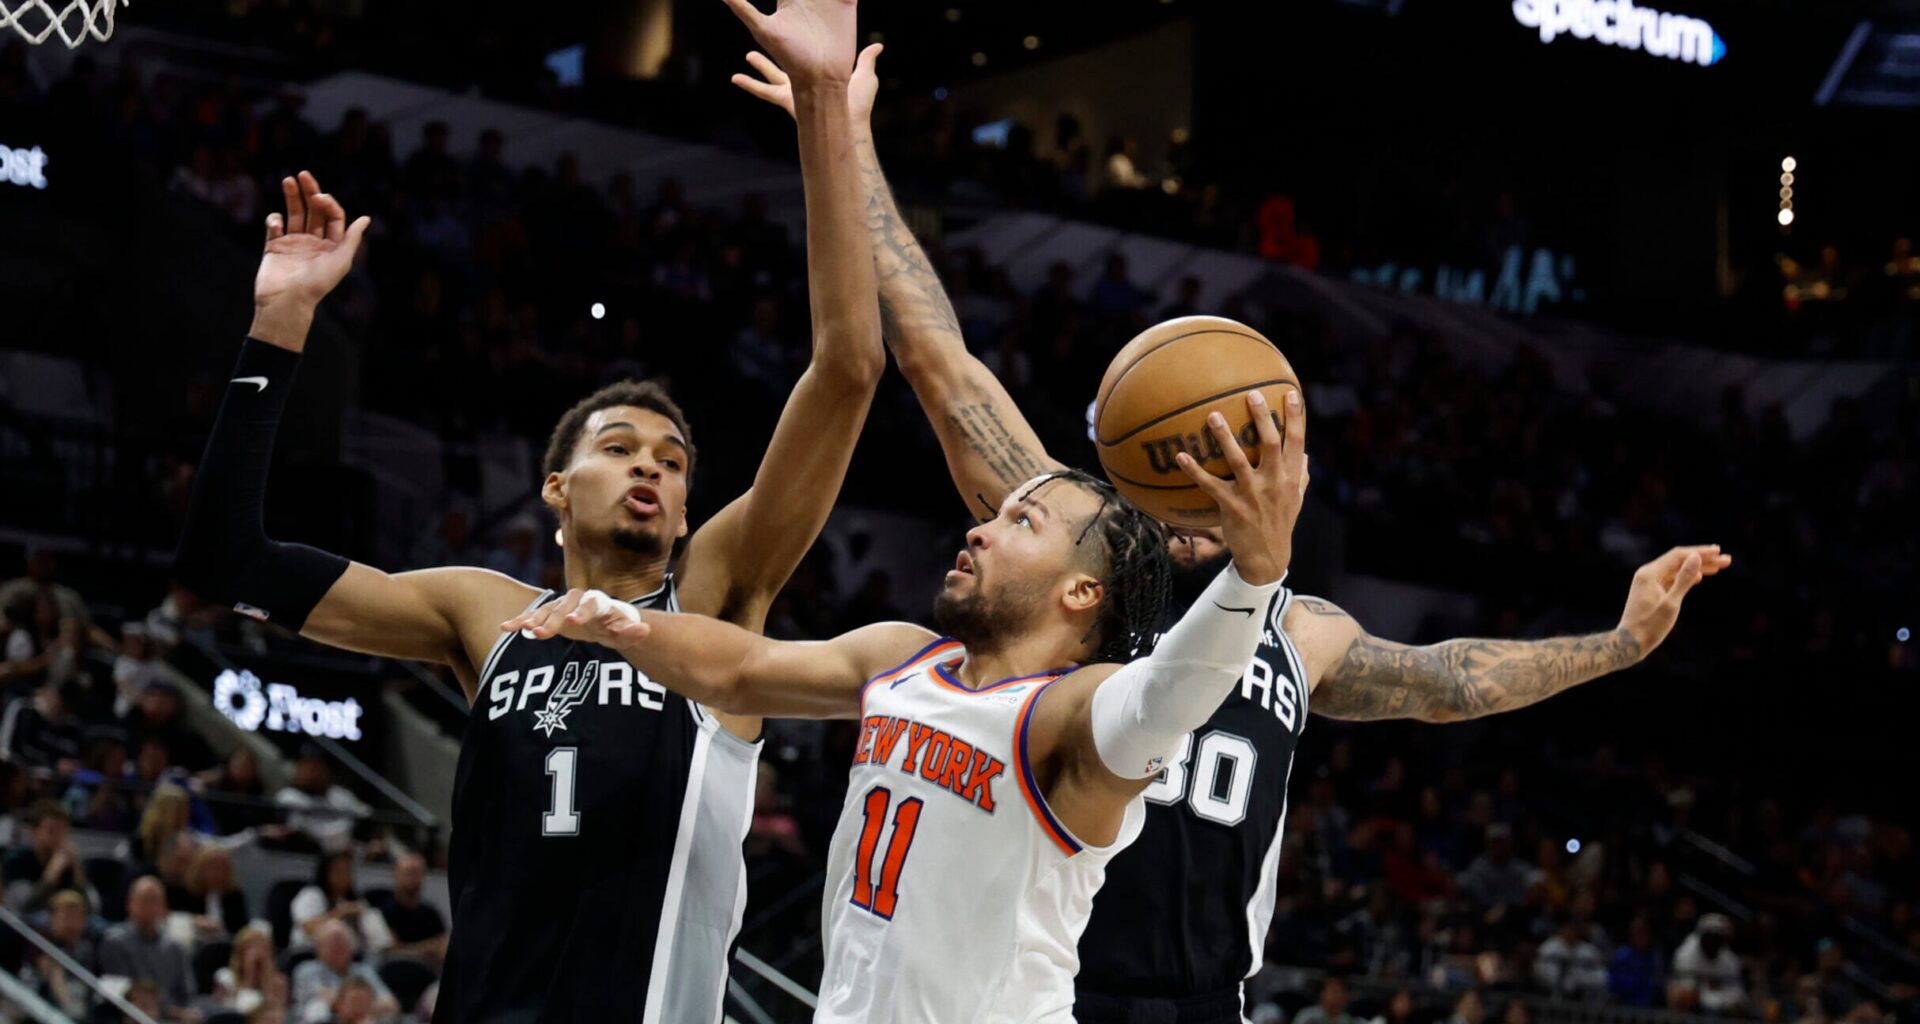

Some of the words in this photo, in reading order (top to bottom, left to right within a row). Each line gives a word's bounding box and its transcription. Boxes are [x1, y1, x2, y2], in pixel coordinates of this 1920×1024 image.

[1140, 409, 1284, 475] Wilo
[265, 682, 363, 741] Frost
[488, 660, 666, 738] SPURS
[541, 746, 581, 837] 1
[853, 715, 909, 766] EW
[901, 719, 1005, 814] YORK
[849, 785, 925, 922] 11
